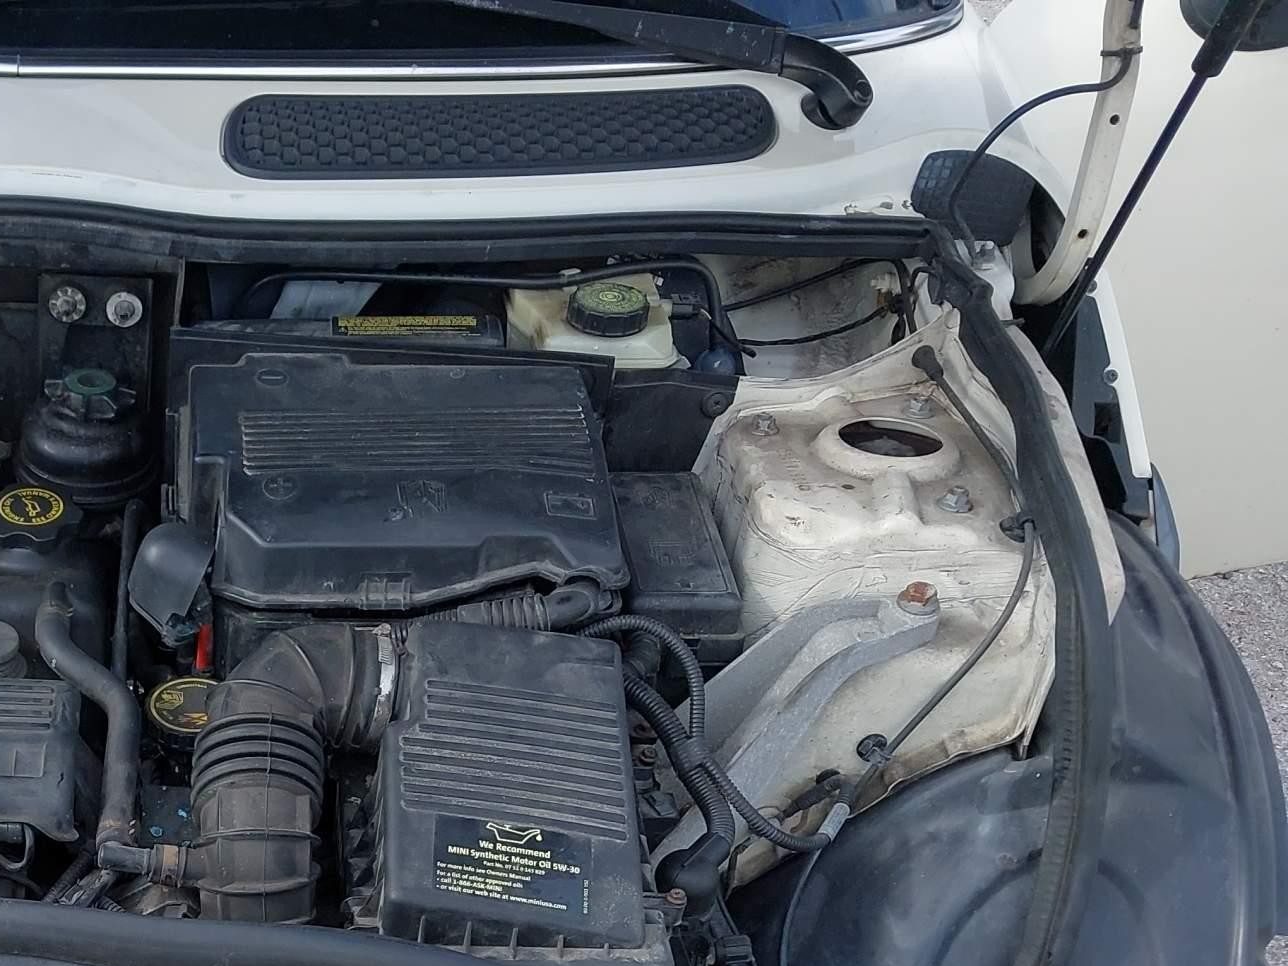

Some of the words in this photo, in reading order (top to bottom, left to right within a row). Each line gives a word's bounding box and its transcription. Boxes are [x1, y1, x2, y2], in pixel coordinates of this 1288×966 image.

[478, 840, 494, 850] We
[496, 842, 551, 859] Recommend
[447, 845, 469, 856] MINI
[470, 849, 510, 862] Synthetic
[511, 855, 537, 867] Motor
[539, 860, 551, 869] Oil
[552, 863, 580, 874] 5W-30
[463, 864, 475, 872] info
[509, 872, 531, 881] Manual
[468, 874, 485, 882] other
[485, 878, 512, 887] approved
[448, 884, 462, 893] visit
[489, 891, 501, 899] site
